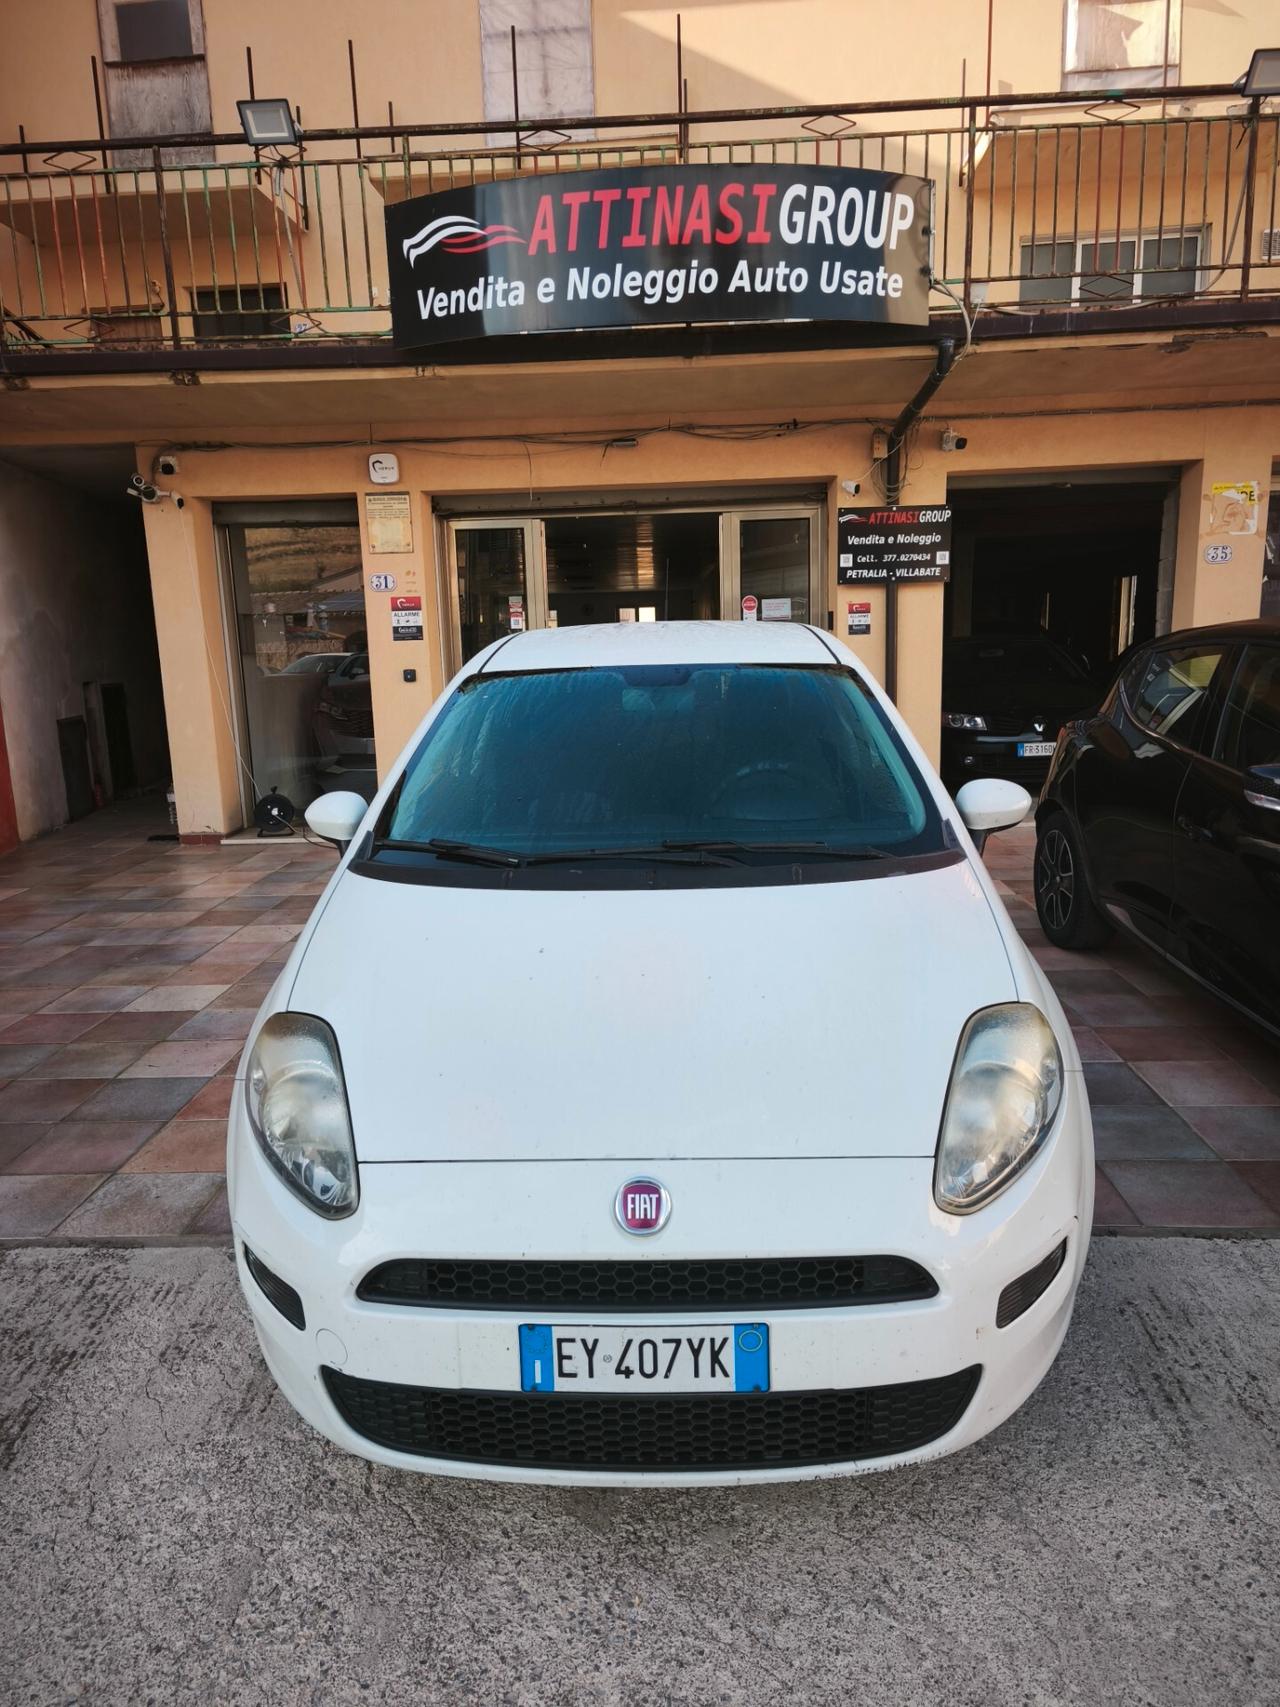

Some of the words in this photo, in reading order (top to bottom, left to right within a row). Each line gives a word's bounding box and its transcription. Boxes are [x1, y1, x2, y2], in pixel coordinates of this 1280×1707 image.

[417, 274, 525, 320] Vendita
[537, 279, 555, 302] e
[567, 261, 718, 304] Noleggio
[728, 260, 809, 294] Auto
[819, 261, 903, 298] Usate
[847, 534, 885, 545] Vendita
[896, 532, 941, 545] Noleggio
[857, 555, 878, 563] Cell.
[1211, 547, 1228, 560] 35
[846, 568, 887, 578] PETRALIA
[895, 567, 941, 577] VILLABATE
[376, 575, 388, 590] 31
[627, 1194, 659, 1219] FIAT
